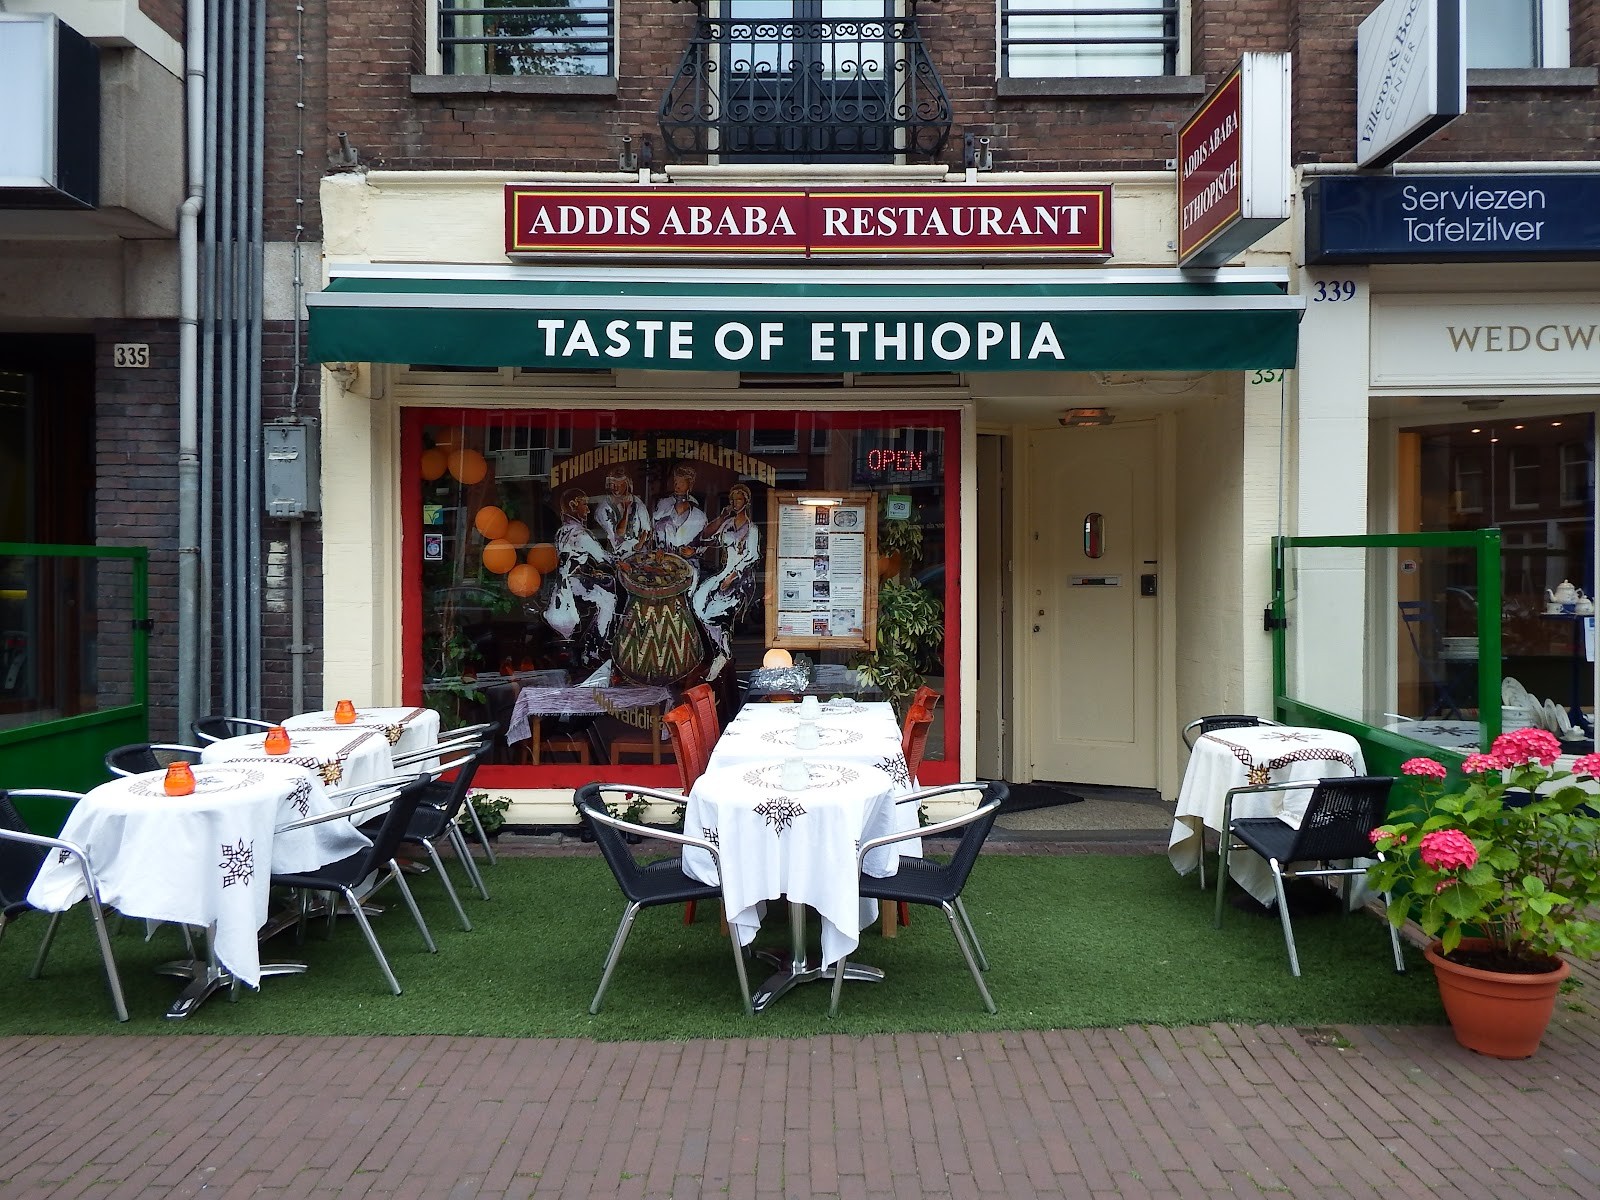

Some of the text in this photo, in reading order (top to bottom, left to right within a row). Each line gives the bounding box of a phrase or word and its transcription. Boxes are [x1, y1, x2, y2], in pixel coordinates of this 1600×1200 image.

[1362, 68, 1393, 142] Villeroy
[1389, 48, 1401, 68] &
[1384, 41, 1416, 121] CENTER
[1182, 109, 1239, 182] ADDIS ABABA
[1182, 159, 1238, 231] ETHIOPISCH
[1401, 185, 1546, 212] Serviezen
[528, 205, 1088, 237] ADDIS ABABA RESTAURANT
[1403, 216, 1545, 243] Tafelzilver
[1313, 280, 1356, 303] 339
[537, 318, 1066, 362] TASTE OF ETHIOPIA
[1447, 324, 1600, 353] WEDGW
[116, 346, 148, 367] 335
[550, 439, 648, 489] ETHIOPISCHE
[868, 449, 923, 471] OPEN
